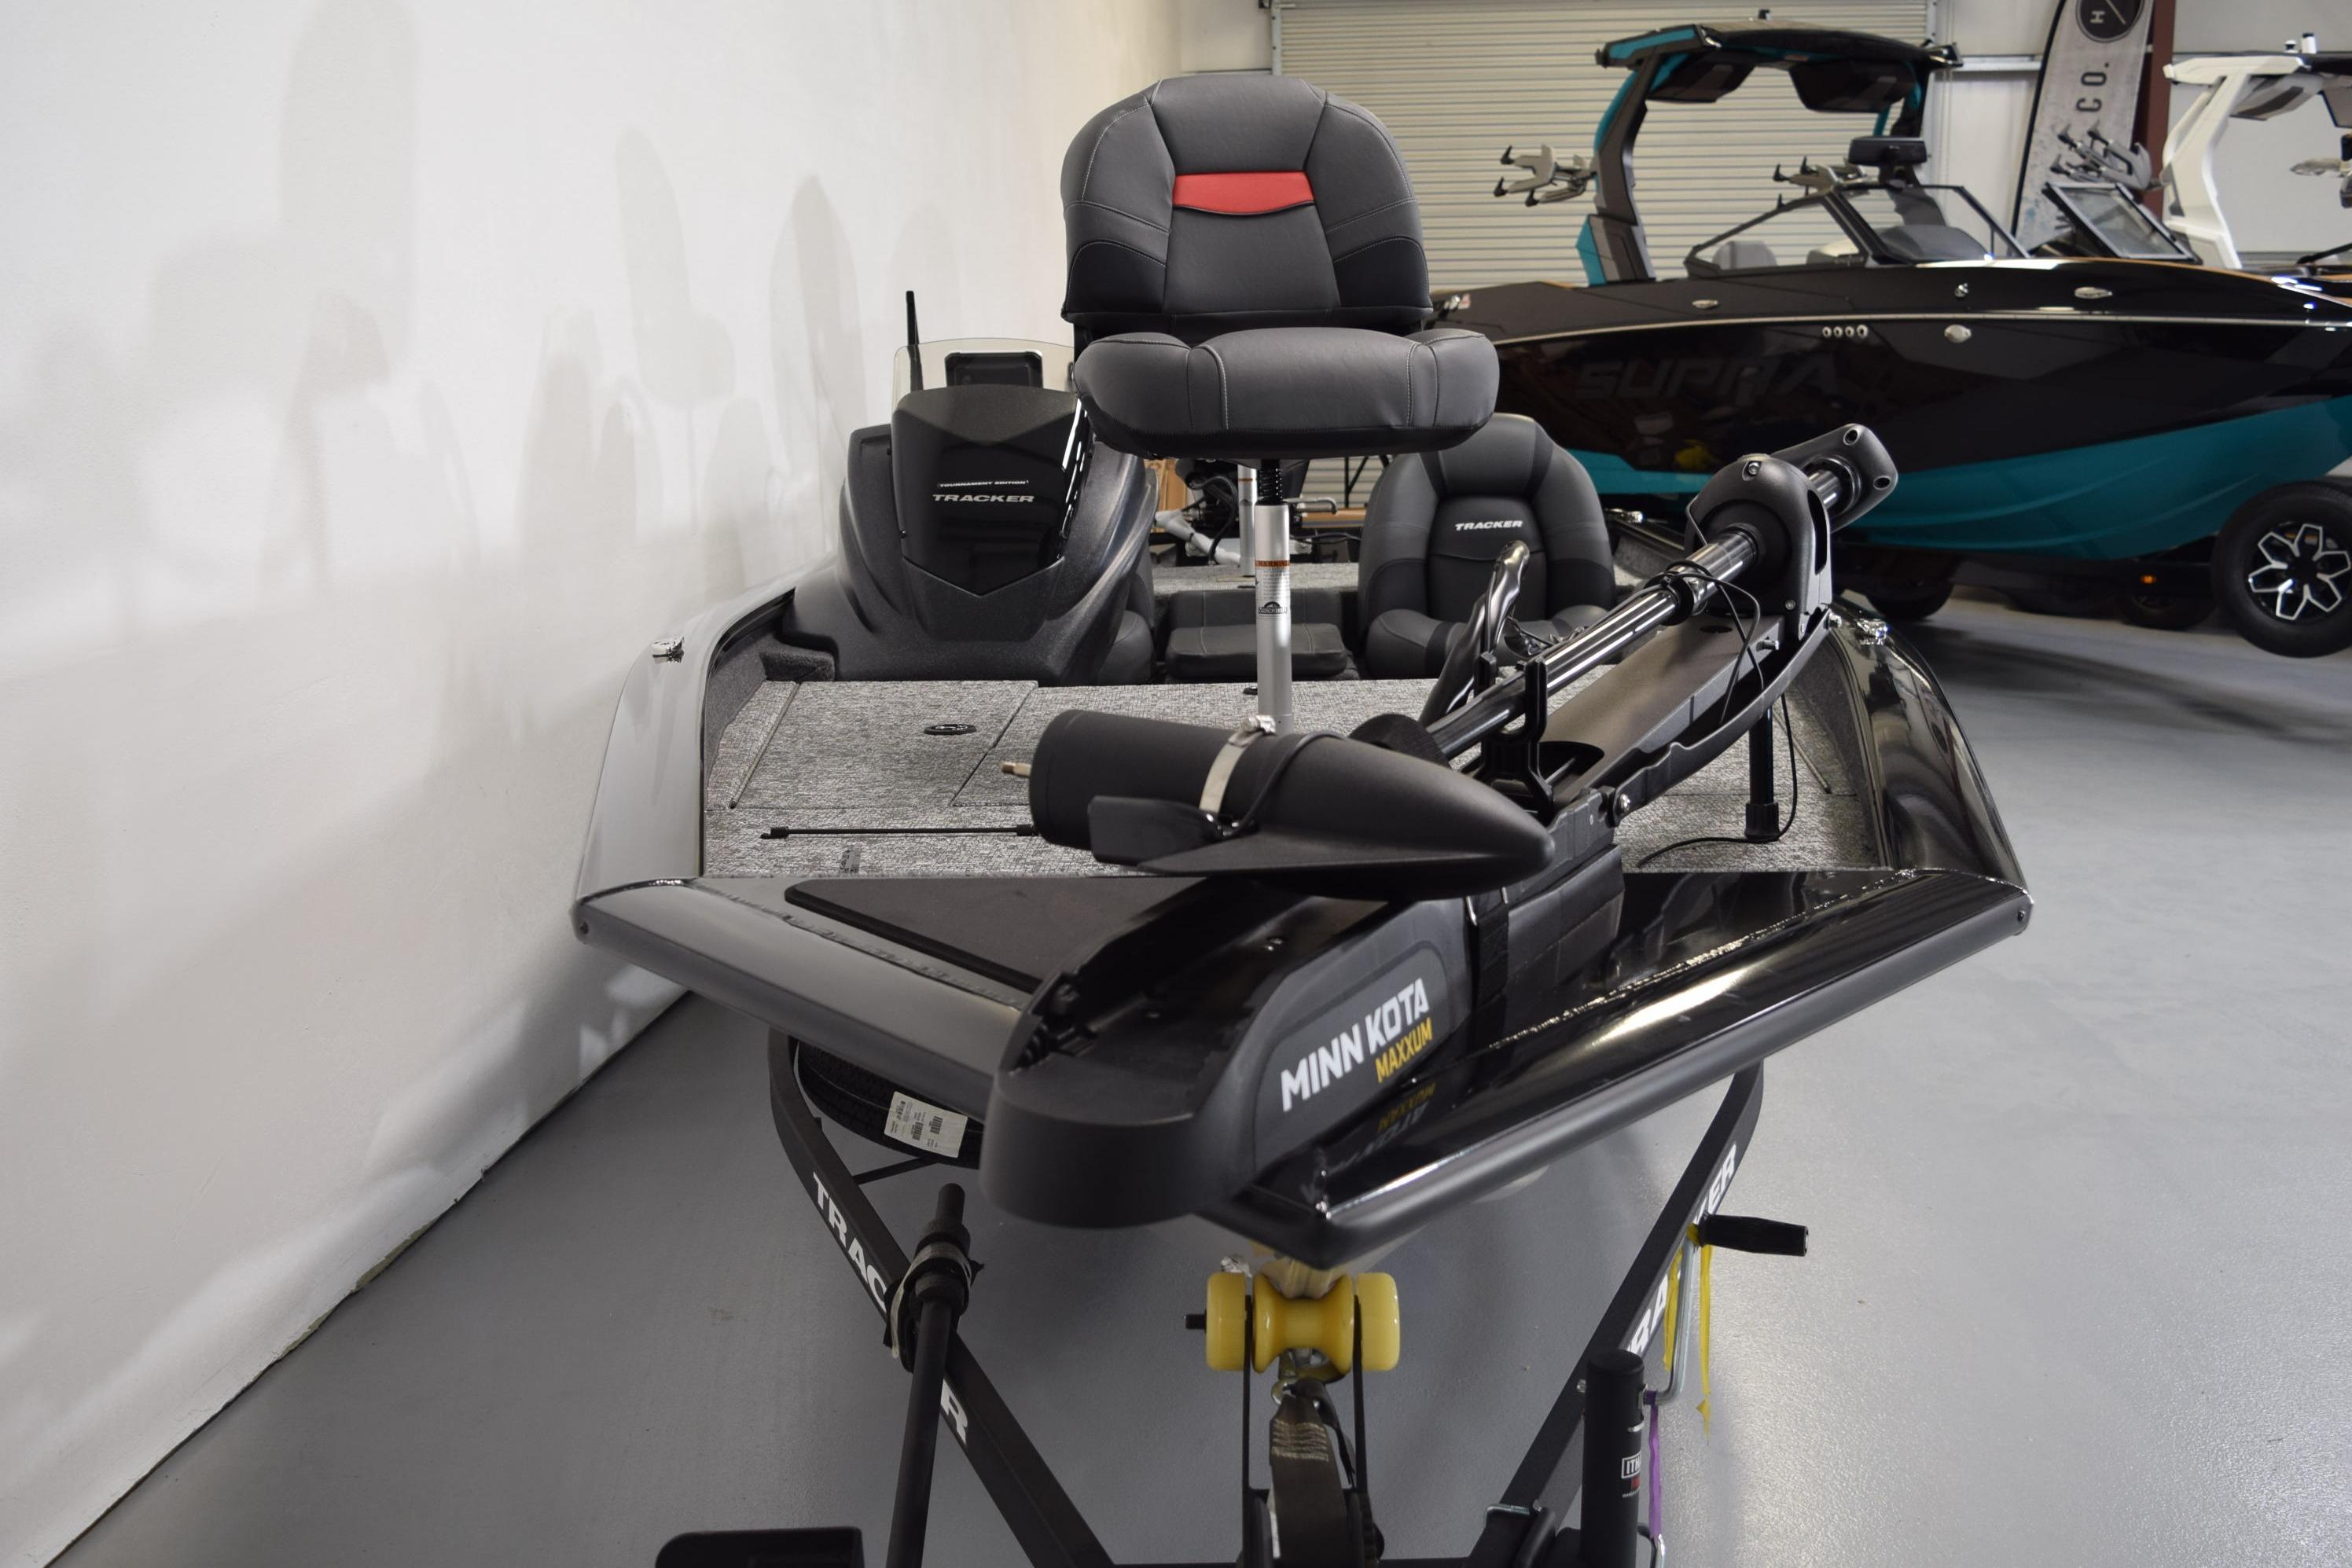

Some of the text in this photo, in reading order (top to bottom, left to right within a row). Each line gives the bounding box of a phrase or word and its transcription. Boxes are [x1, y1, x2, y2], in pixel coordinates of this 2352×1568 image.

[1575, 354, 1839, 400] SUPRA
[932, 494, 1035, 503] TRACKER
[1454, 520, 1523, 531] TRACKER
[1281, 1022, 1365, 1113] MINN
[1365, 977, 1430, 1056] KOTA
[1375, 1016, 1433, 1084] MAXXUM
[812, 1170, 968, 1445] TRACR
